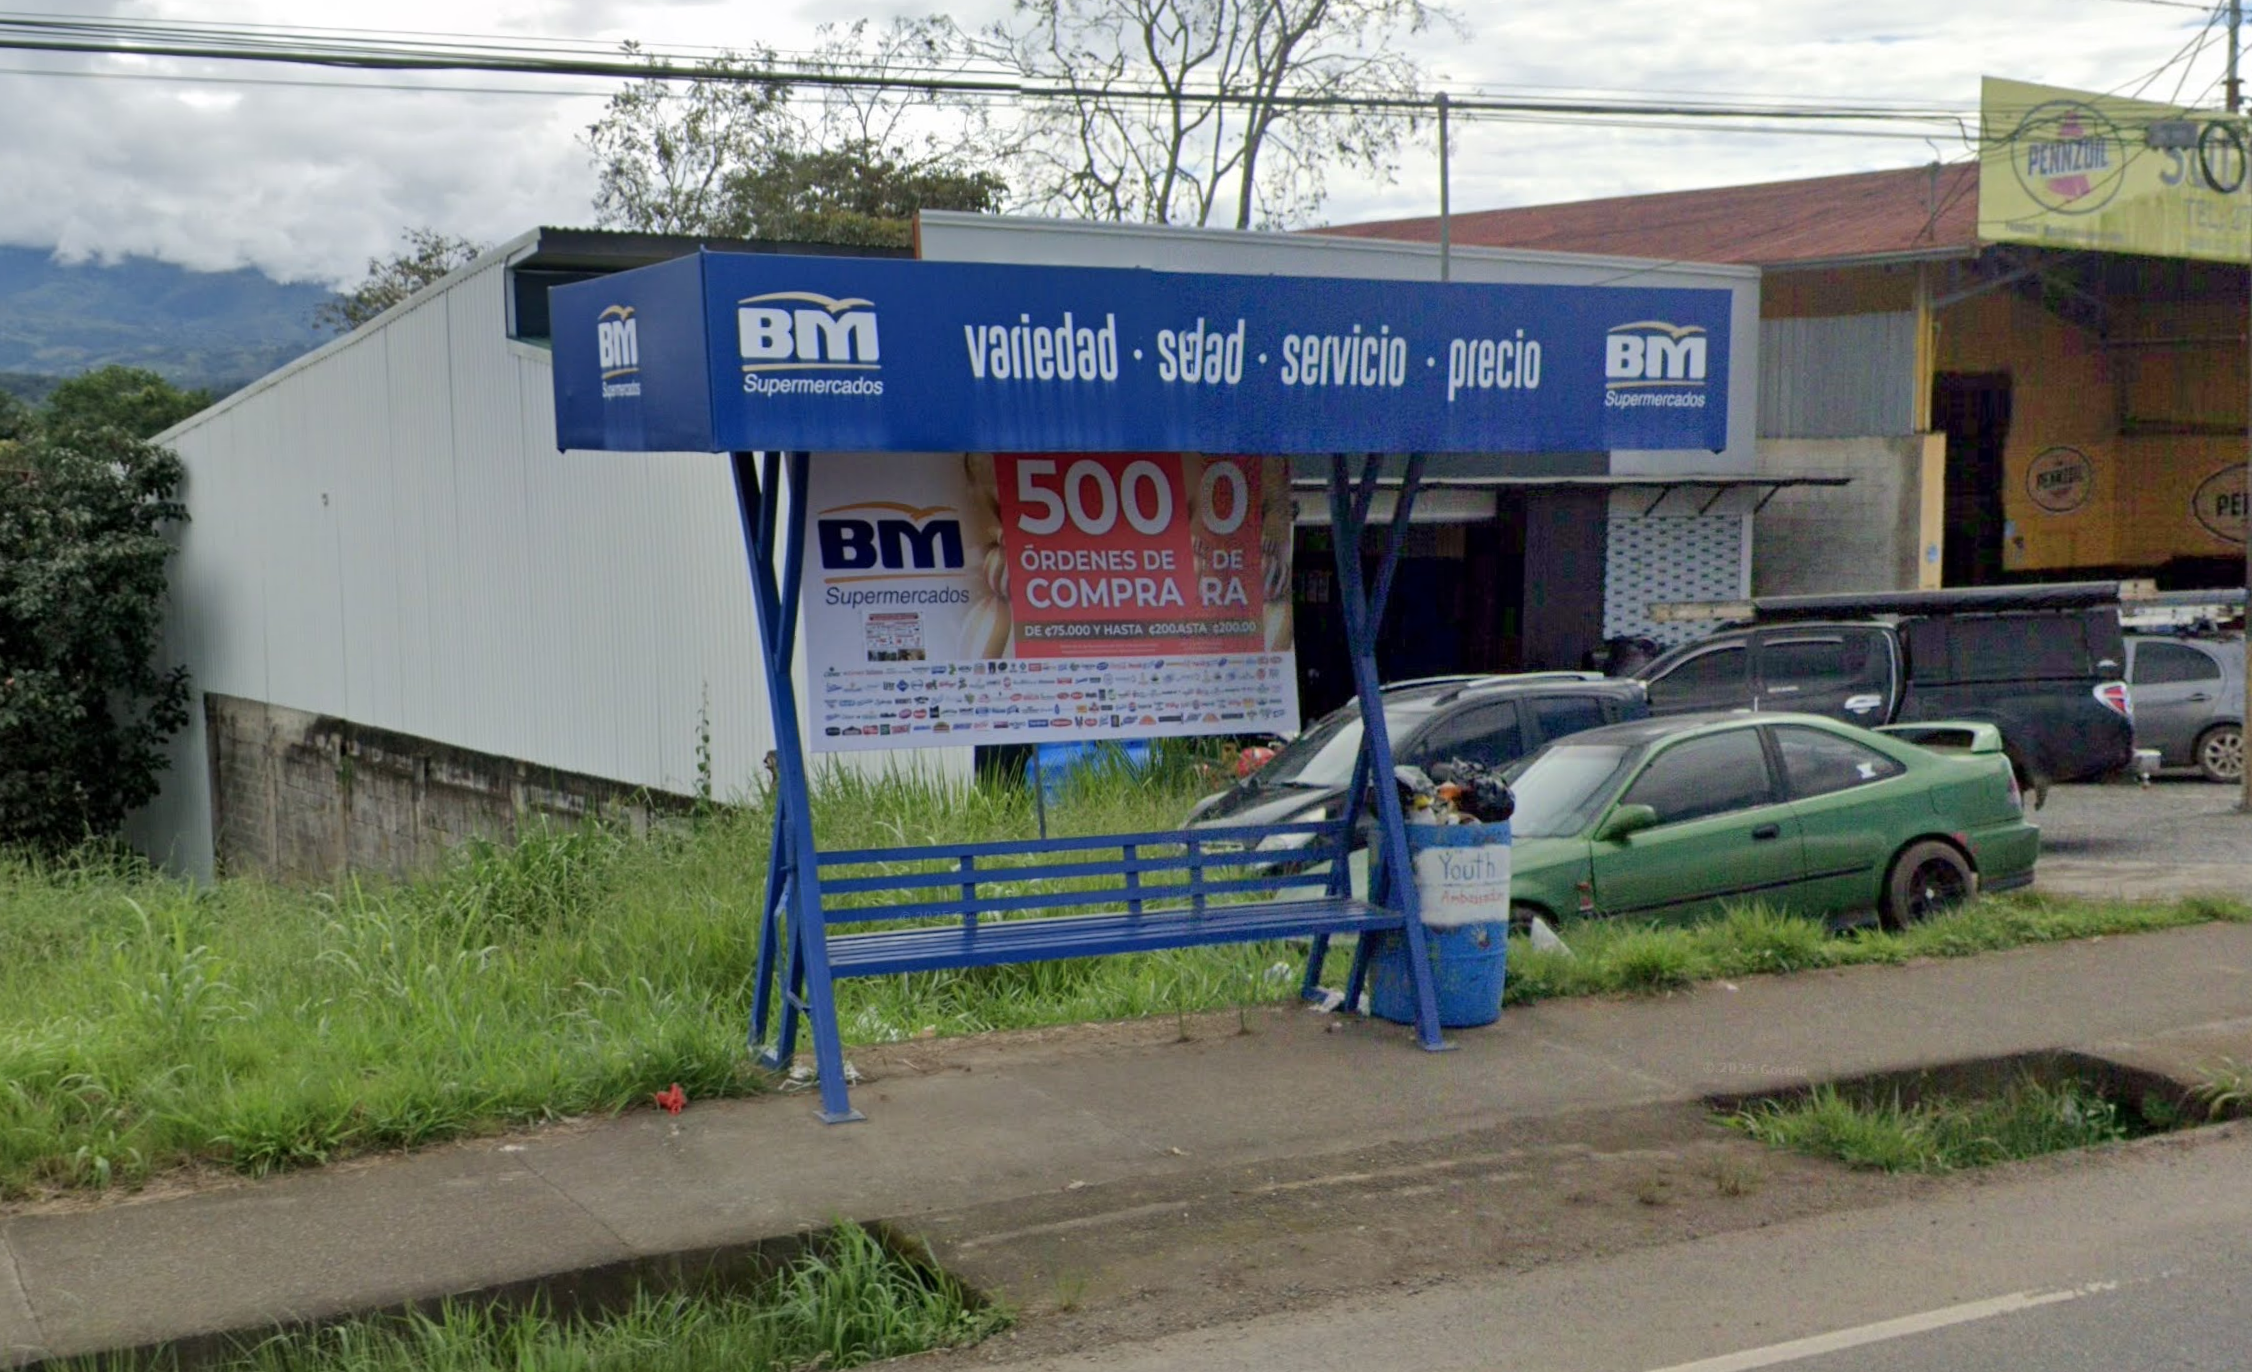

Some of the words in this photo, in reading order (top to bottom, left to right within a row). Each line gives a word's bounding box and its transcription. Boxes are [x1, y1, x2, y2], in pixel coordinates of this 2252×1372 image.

[597, 318, 638, 368] BM
[738, 307, 880, 362] BM
[964, 313, 1119, 382] variedad
[1281, 324, 1407, 388] servicio
[1448, 328, 1541, 402] precio
[1605, 334, 1706, 379] BM
[743, 373, 884, 397] Supermercados
[1605, 389, 1706, 409] Supermercados
[1017, 459, 1174, 535] 500
[818, 519, 965, 570] BM
[1020, 544, 1137, 572] ÓRDENES
[1145, 549, 1176, 571] DE
[1213, 550, 1243, 571] DE
[825, 586, 970, 609] Supermercados
[1026, 576, 1185, 609] COMPRA
[1202, 577, 1249, 607] RA
[1024, 626, 1042, 636] DE
[1093, 625, 1100, 635] Y
[1104, 624, 1144, 636] HASTA
[1438, 852, 1496, 880] Youth
